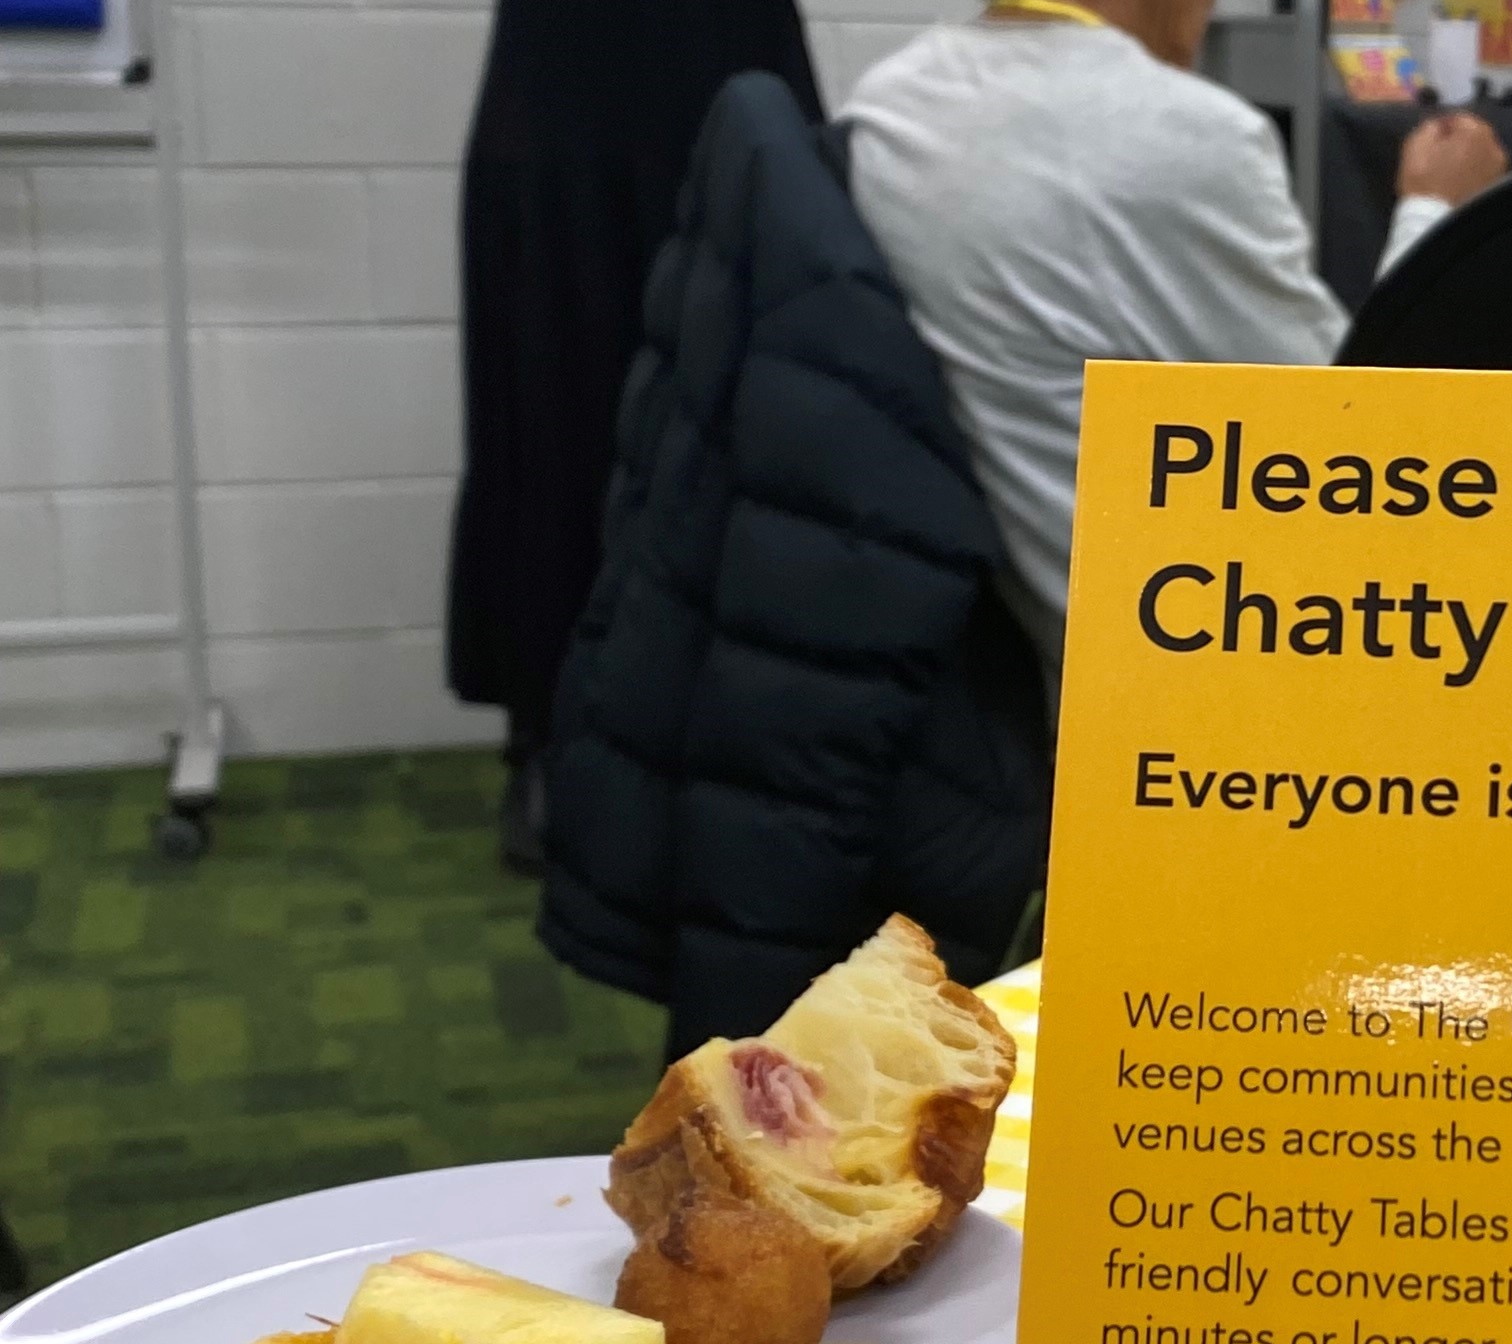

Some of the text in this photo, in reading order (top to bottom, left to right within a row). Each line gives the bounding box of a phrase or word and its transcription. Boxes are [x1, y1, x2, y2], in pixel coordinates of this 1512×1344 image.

[1146, 419, 1500, 522] Please
[1134, 562, 1510, 689] Chatty
[1131, 749, 1463, 832] Everyone
[1123, 990, 1329, 1038] Welcome
[1346, 1004, 1392, 1041] to
[1408, 1001, 1491, 1043] The
[1116, 1049, 1225, 1105] keep
[1113, 1119, 1267, 1154] venues
[1281, 1123, 1417, 1161] across
[1432, 1121, 1502, 1164] the
[1107, 1187, 1195, 1229] Our
[1208, 1191, 1353, 1246] Chatty
[1370, 1197, 1509, 1243] Tables
[1103, 1248, 1269, 1306] friendly
